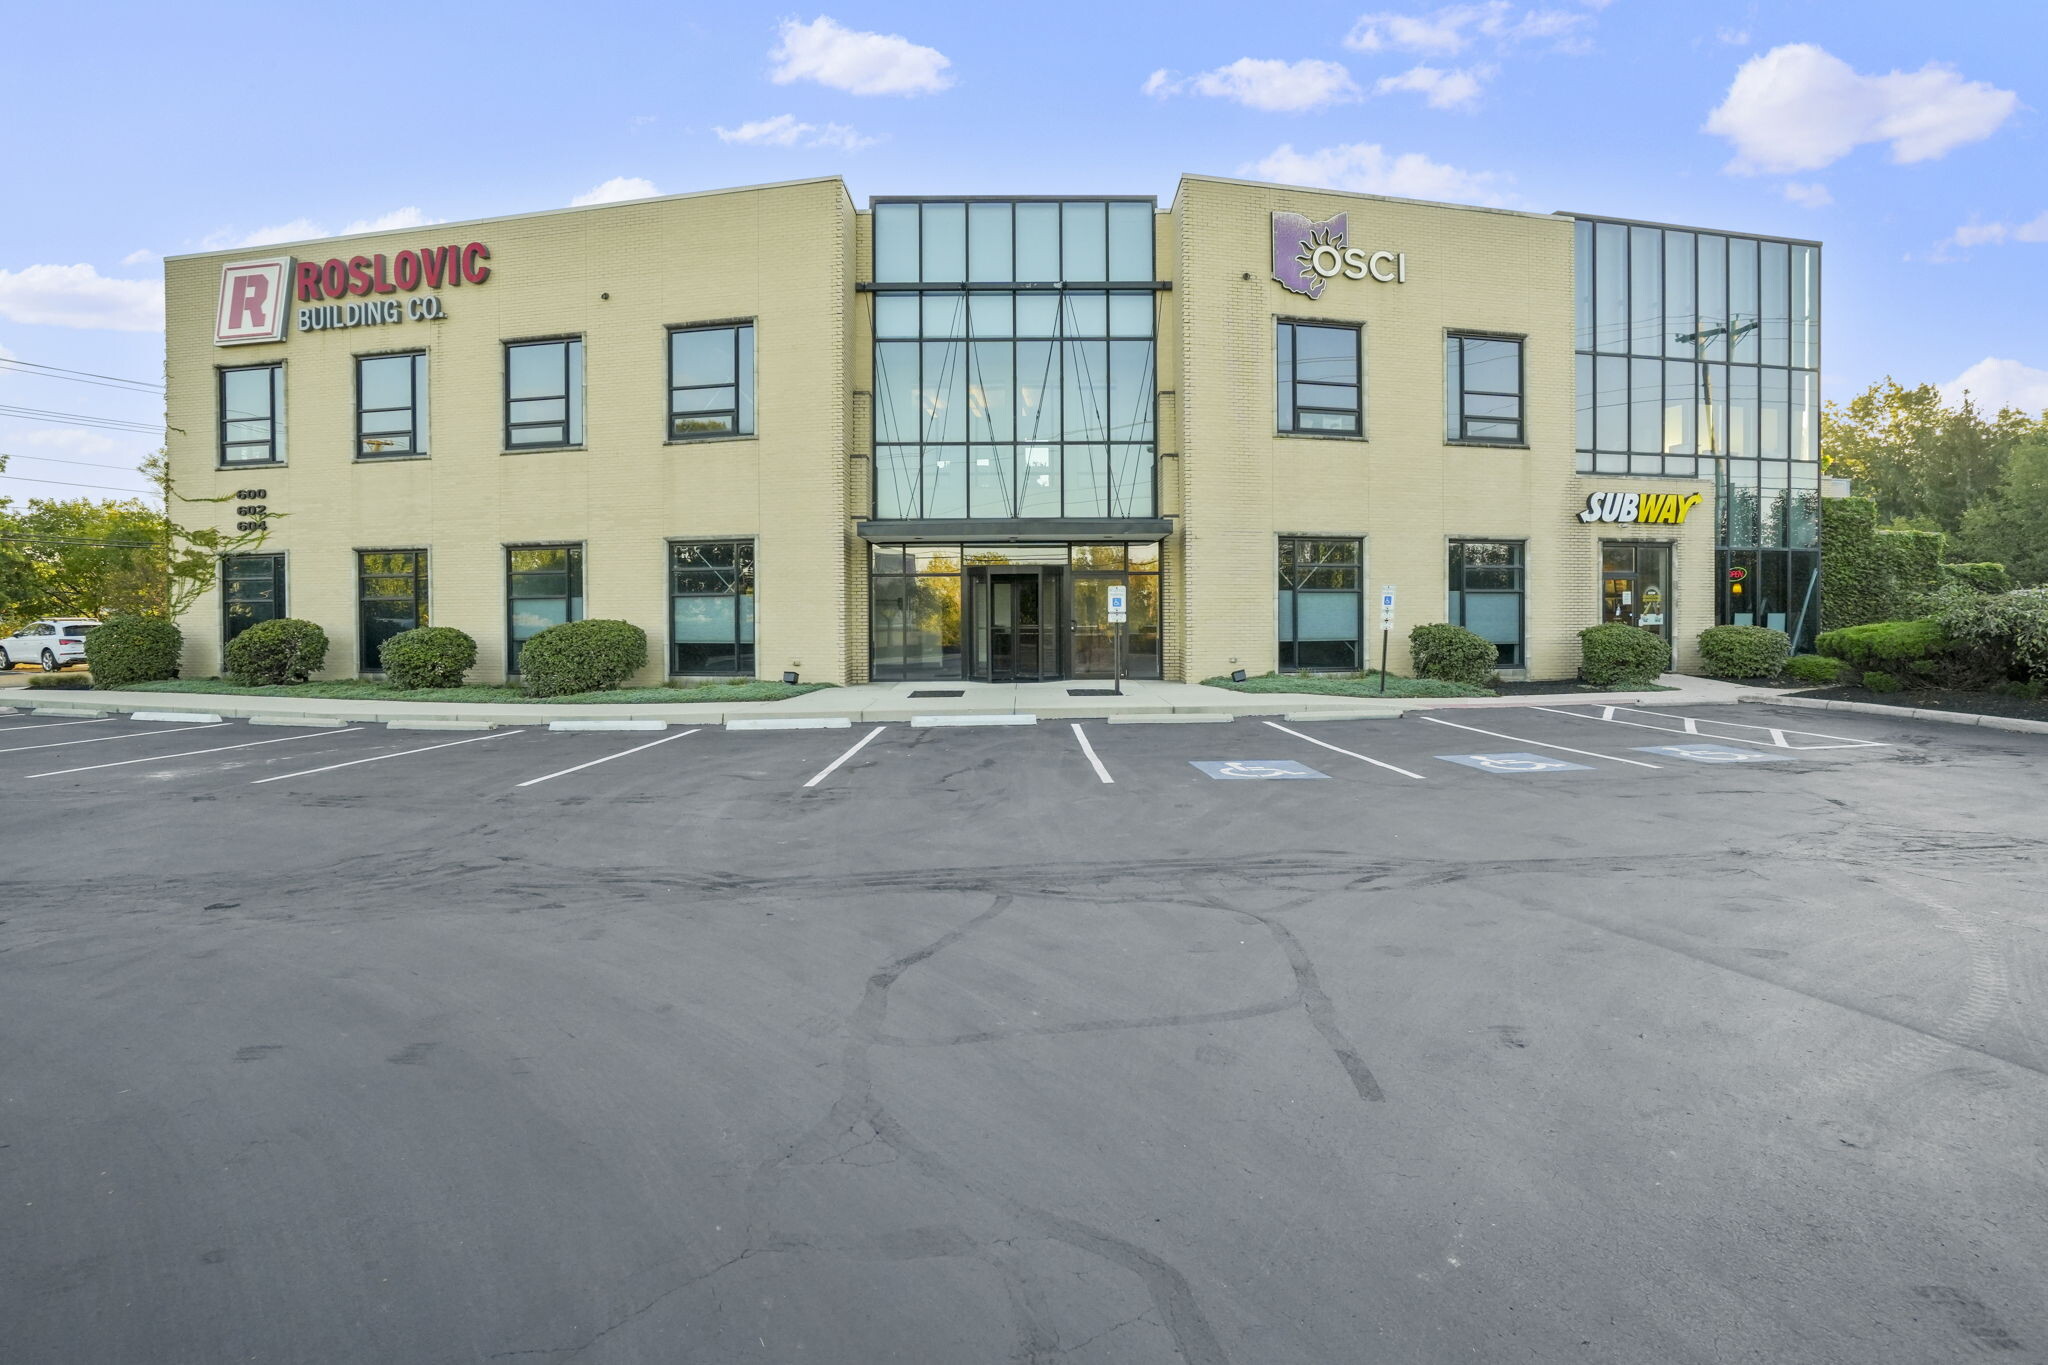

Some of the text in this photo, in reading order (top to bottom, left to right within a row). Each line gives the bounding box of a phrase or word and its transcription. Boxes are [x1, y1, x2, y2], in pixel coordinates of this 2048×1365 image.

[297, 242, 490, 301] ROSLOVIC
[1312, 245, 1405, 283] OSCI
[228, 274, 269, 330] R
[298, 295, 447, 332] BUILDING CO.
[237, 489, 267, 500] 600
[237, 505, 267, 516] 602
[1578, 491, 1703, 524] SUBWAY
[237, 520, 267, 531] 604
